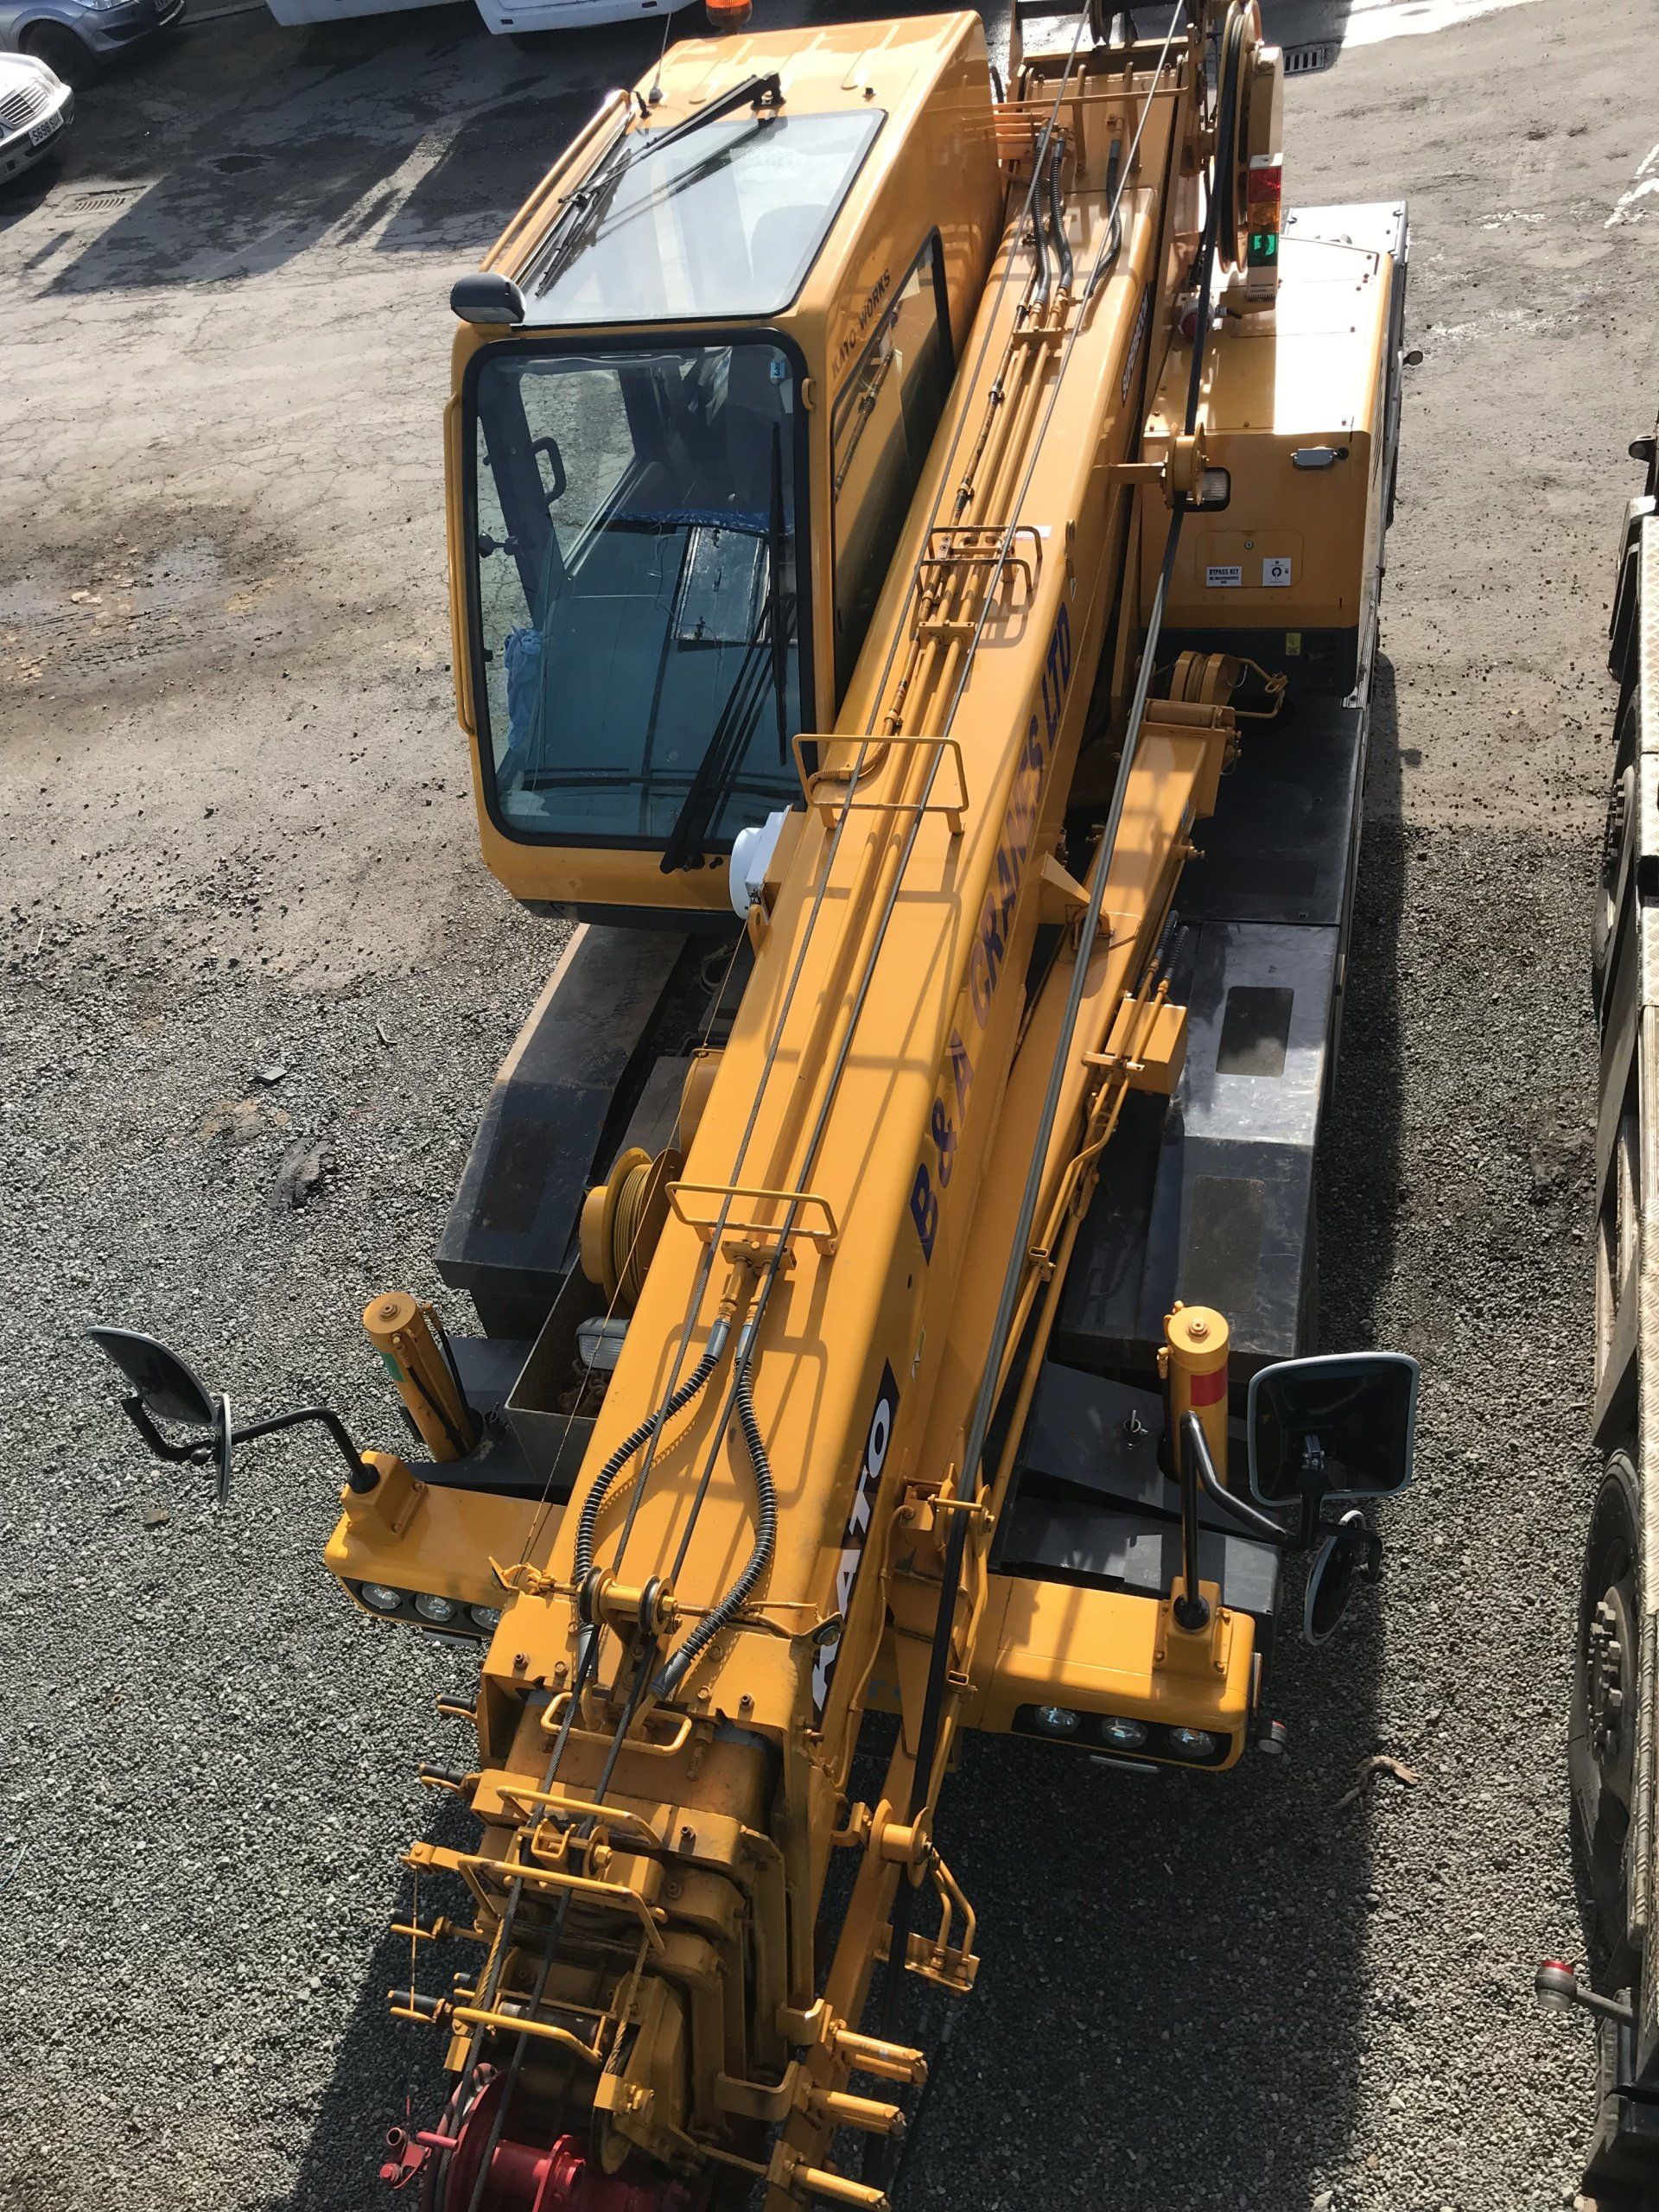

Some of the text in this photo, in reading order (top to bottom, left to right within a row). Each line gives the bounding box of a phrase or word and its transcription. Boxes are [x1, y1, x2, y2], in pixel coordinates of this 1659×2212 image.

[831, 268, 890, 379] KATO WORKS
[910, 1163, 939, 1268] B
[970, 714, 1045, 1031] CRANES
[1042, 601, 1071, 753] LTD
[811, 1397, 892, 1713] KATO
